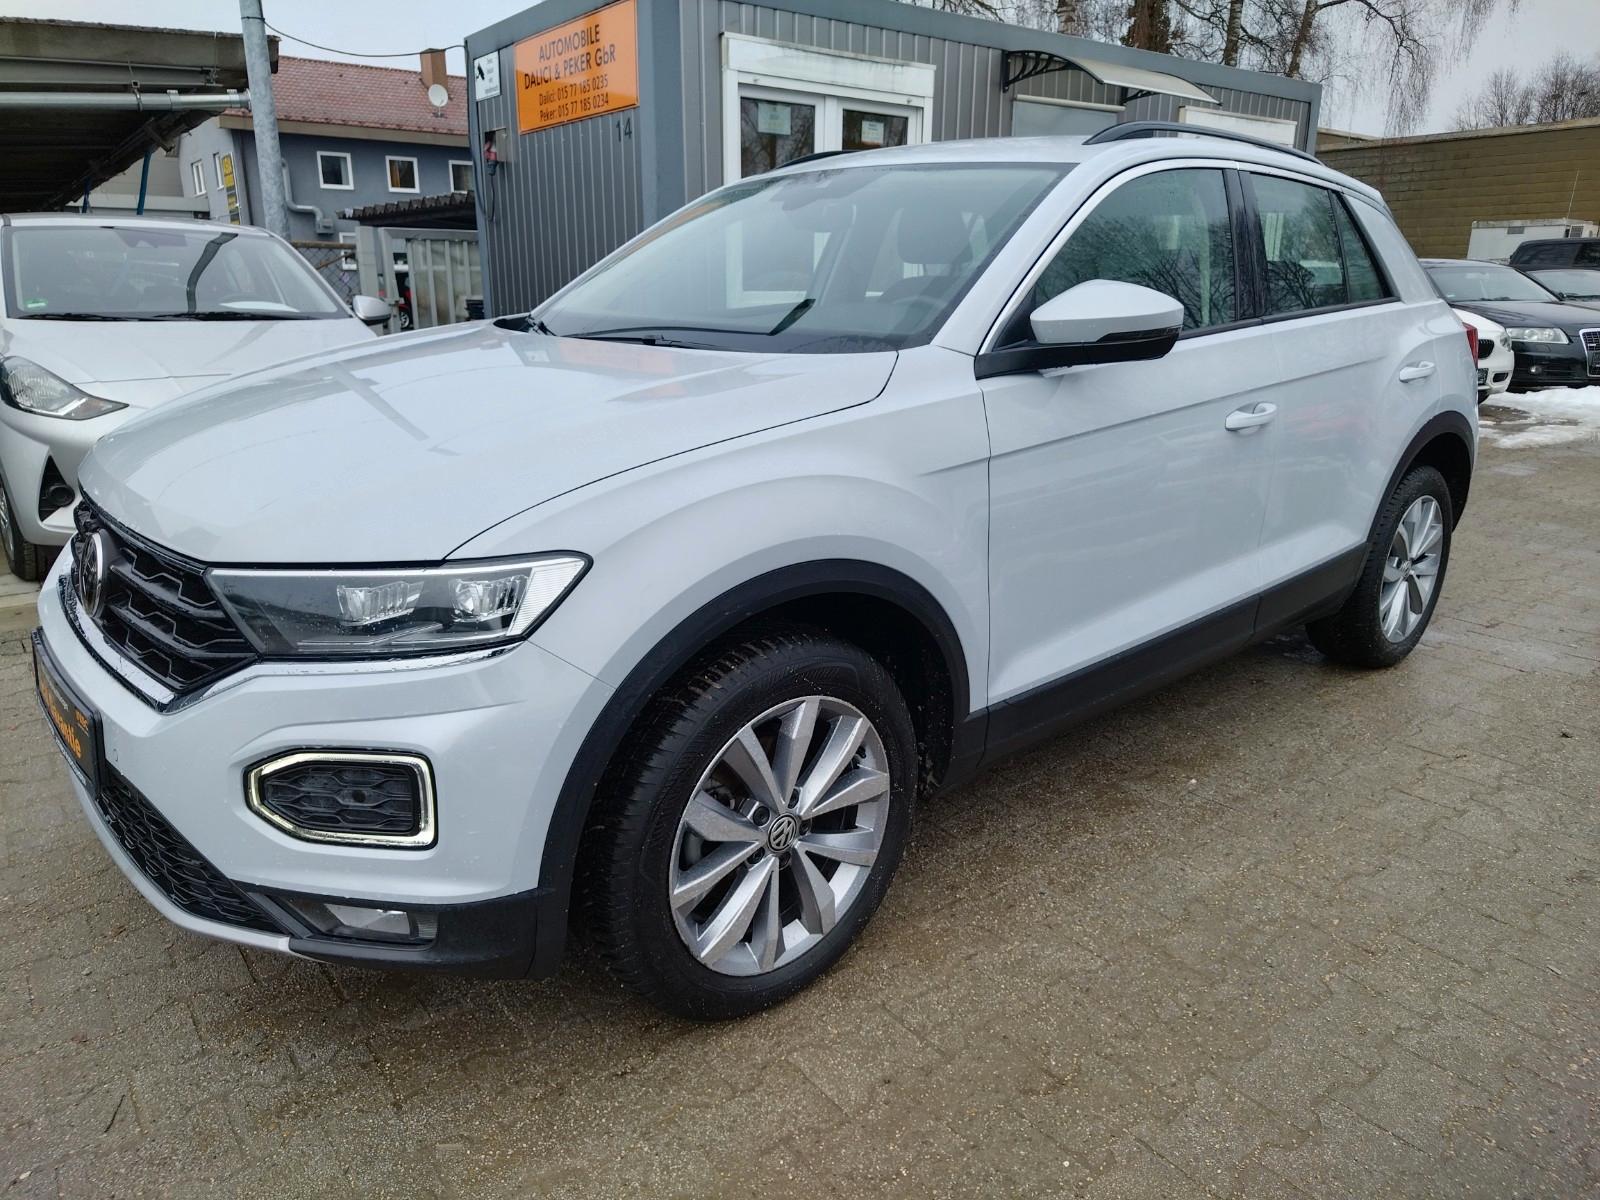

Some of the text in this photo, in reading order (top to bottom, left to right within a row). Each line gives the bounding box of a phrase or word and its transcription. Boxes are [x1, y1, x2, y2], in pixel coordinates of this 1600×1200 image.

[539, 24, 600, 63] AUTOMOBILE
[555, 63, 561, 80] &
[564, 52, 592, 78] PEKER
[594, 43, 616, 67] GbR
[557, 85, 569, 101] 015
[569, 83, 577, 97] 77
[558, 102, 569, 118] 015
[570, 100, 578, 115] 77
[580, 97, 591, 112] 185
[592, 92, 609, 109] 0234
[615, 117, 633, 142] 14
